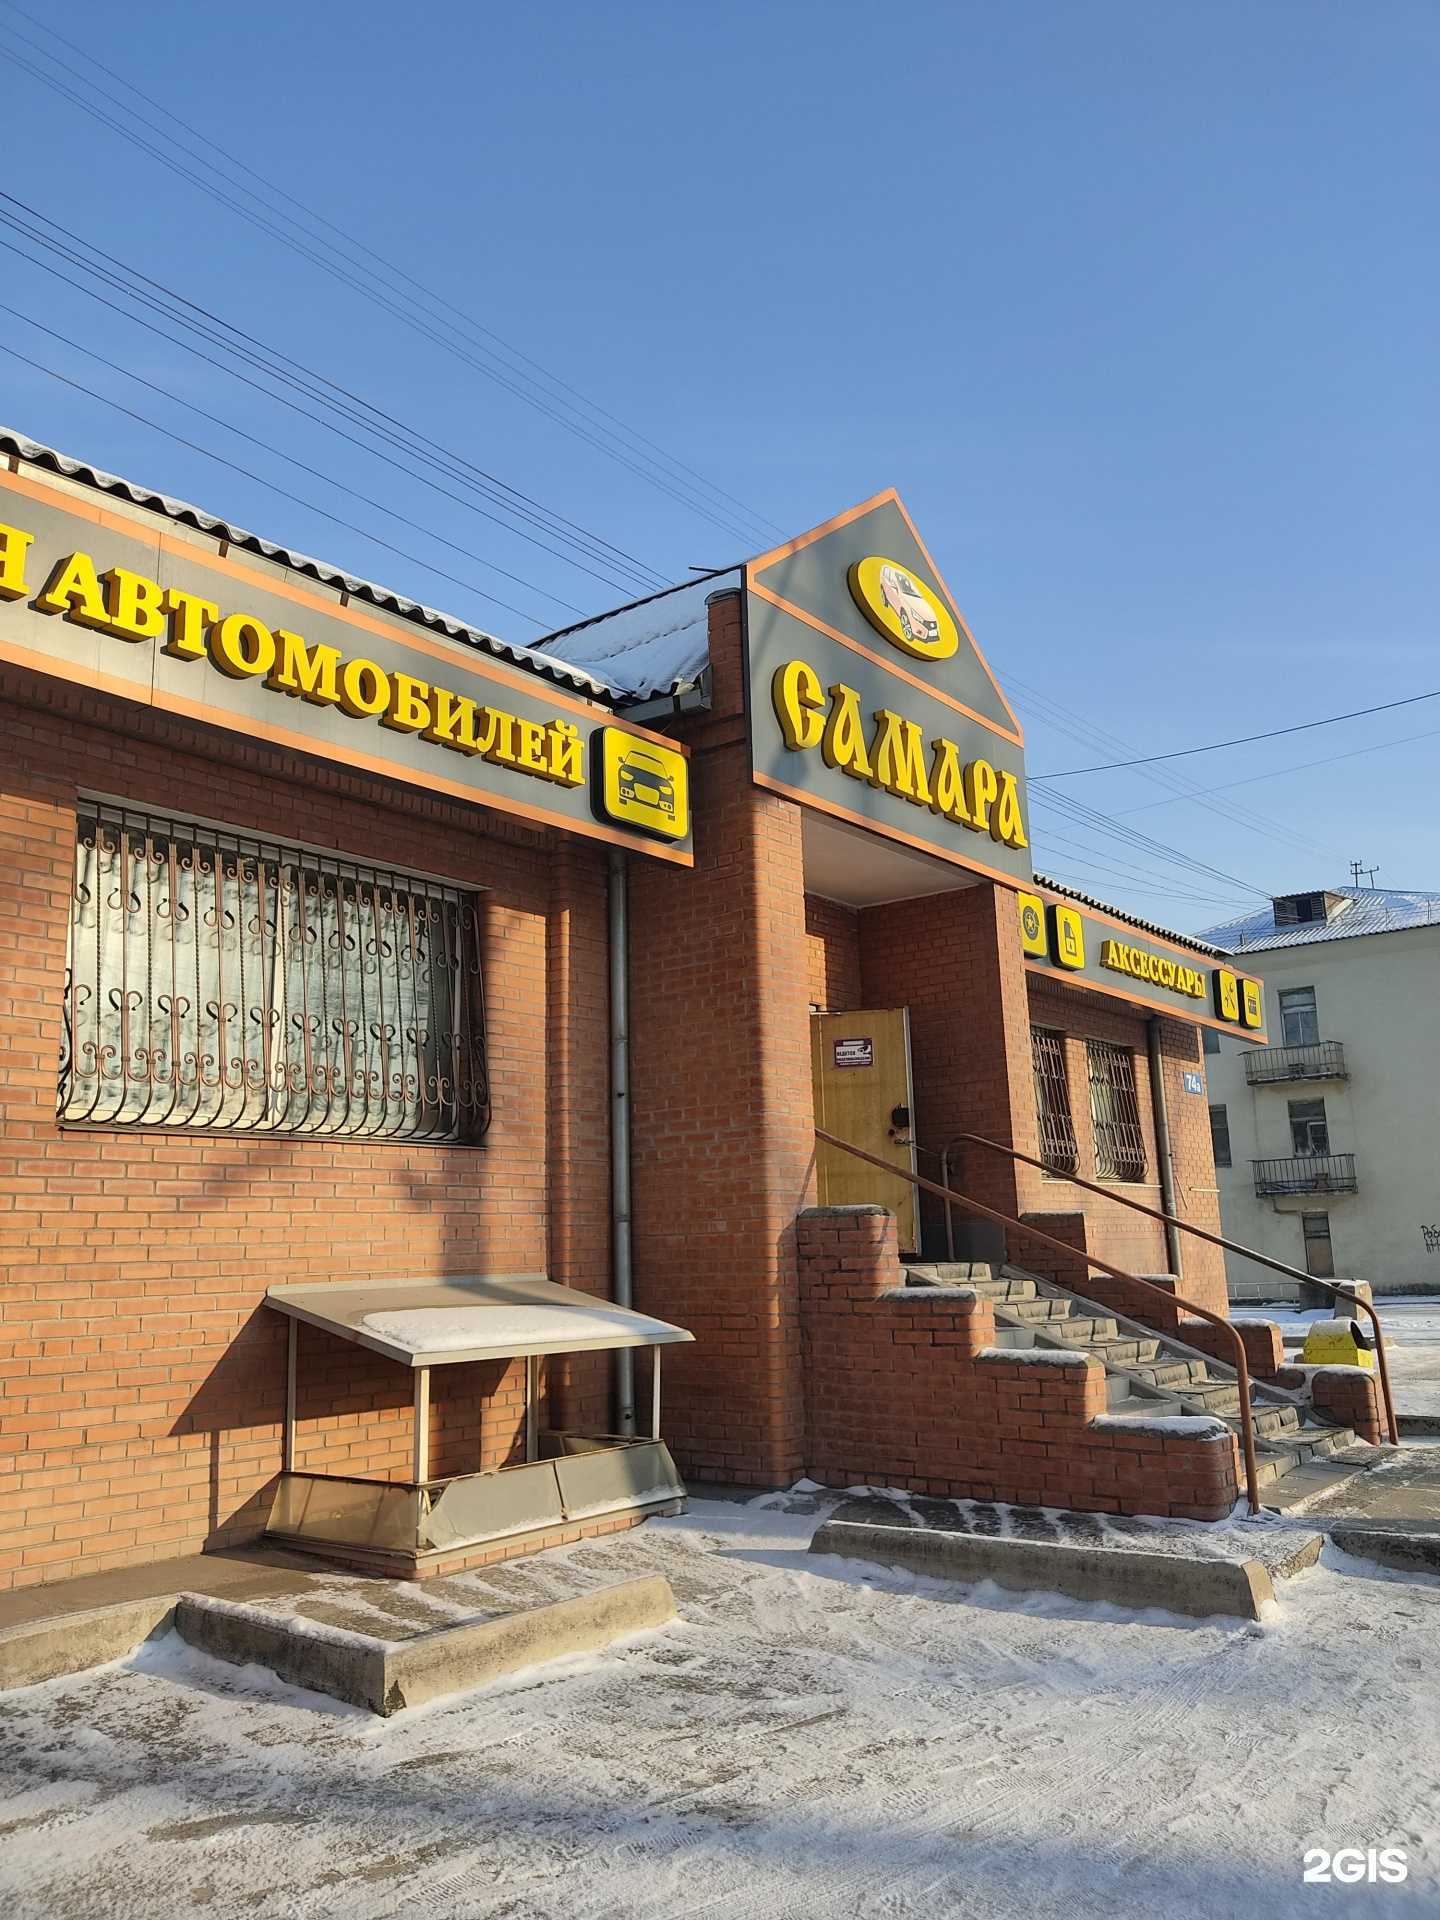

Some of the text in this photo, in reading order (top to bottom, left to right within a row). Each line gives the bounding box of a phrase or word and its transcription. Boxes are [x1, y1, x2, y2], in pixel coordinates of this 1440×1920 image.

[42, 550, 587, 789] АВТОМОБИЛЕЙ
[777, 660, 1028, 849] САМАРА
[1105, 938, 1207, 998] АКСЕССУАРЫ
